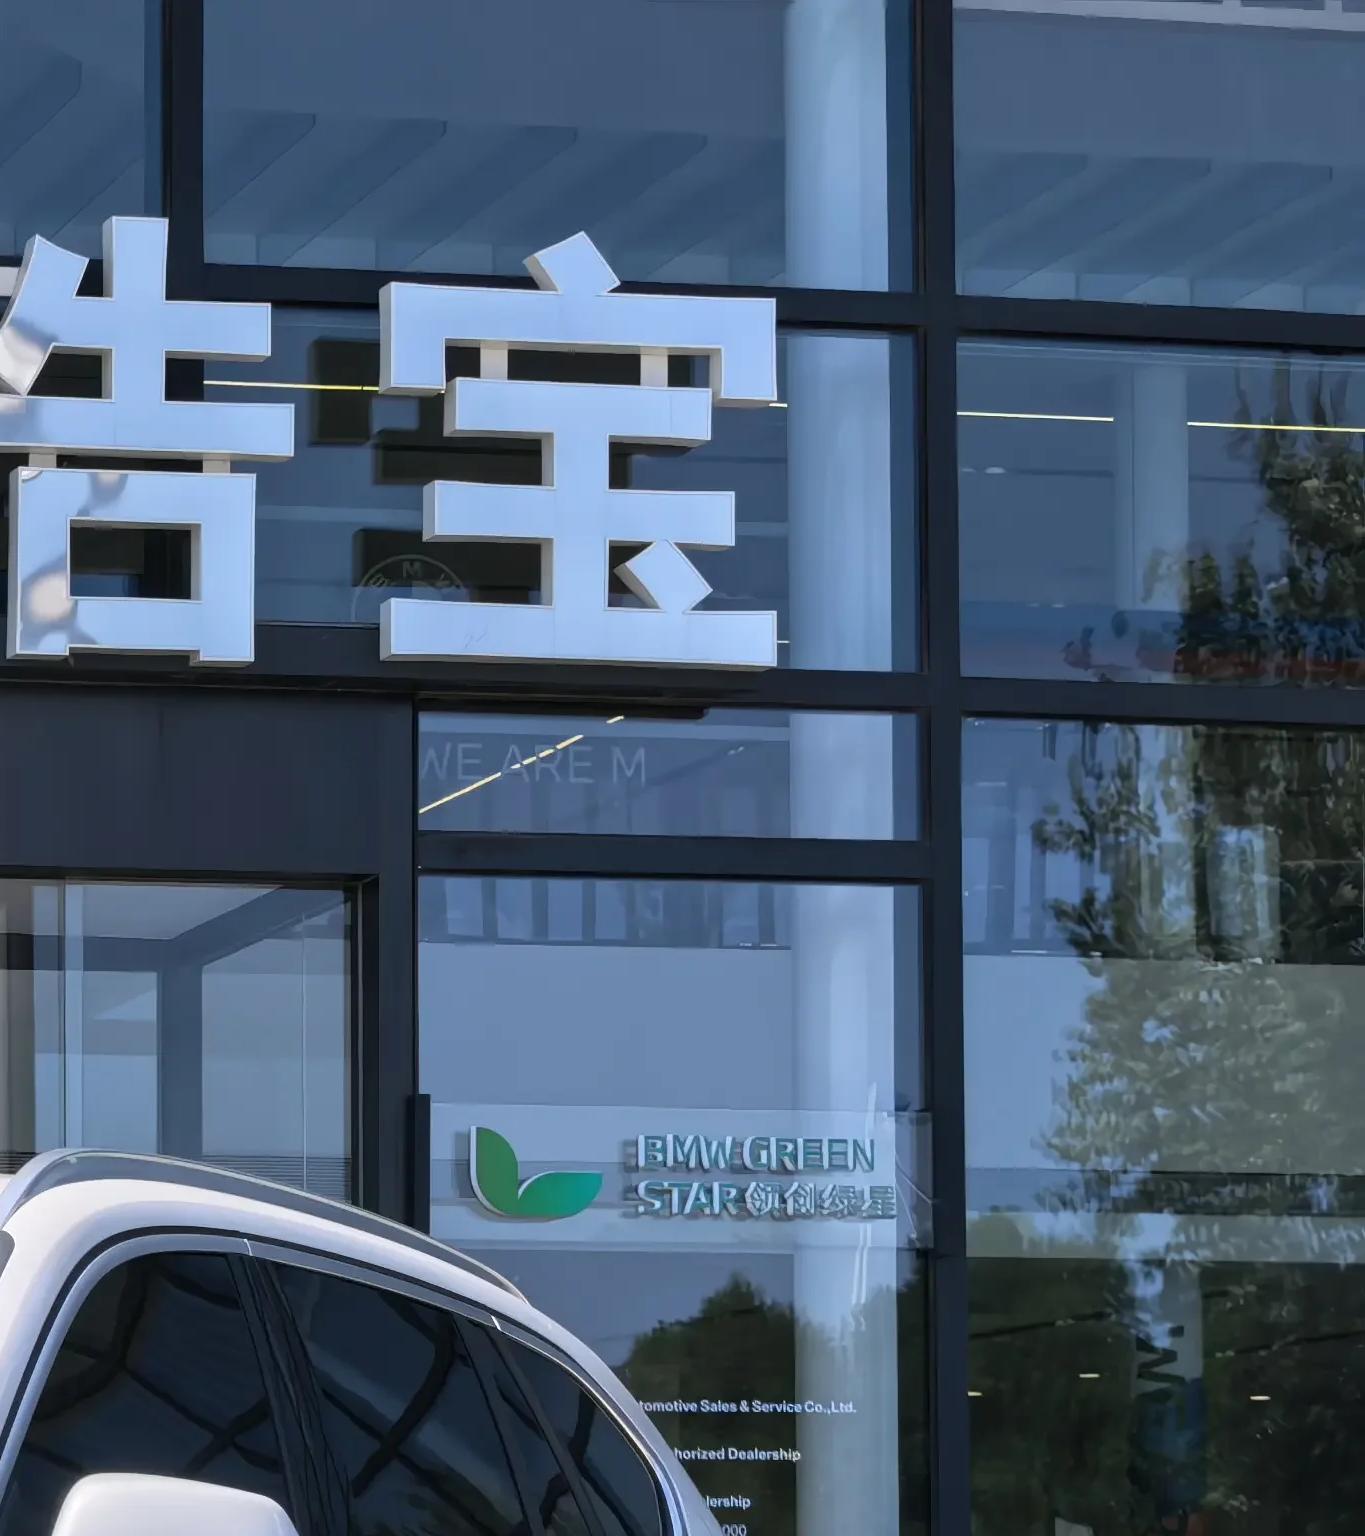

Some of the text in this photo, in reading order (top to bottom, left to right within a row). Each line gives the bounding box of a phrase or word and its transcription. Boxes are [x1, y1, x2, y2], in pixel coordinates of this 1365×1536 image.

[501, 743, 597, 784] ARE
[611, 745, 647, 788] M
[637, 1133, 876, 1172] BMW GREEN
[637, 1179, 741, 1216] STAR
[700, 1400, 738, 1413] Sales
[739, 1400, 750, 1413] &
[751, 1400, 803, 1413] Service
[727, 1446, 802, 1463] Dealership
